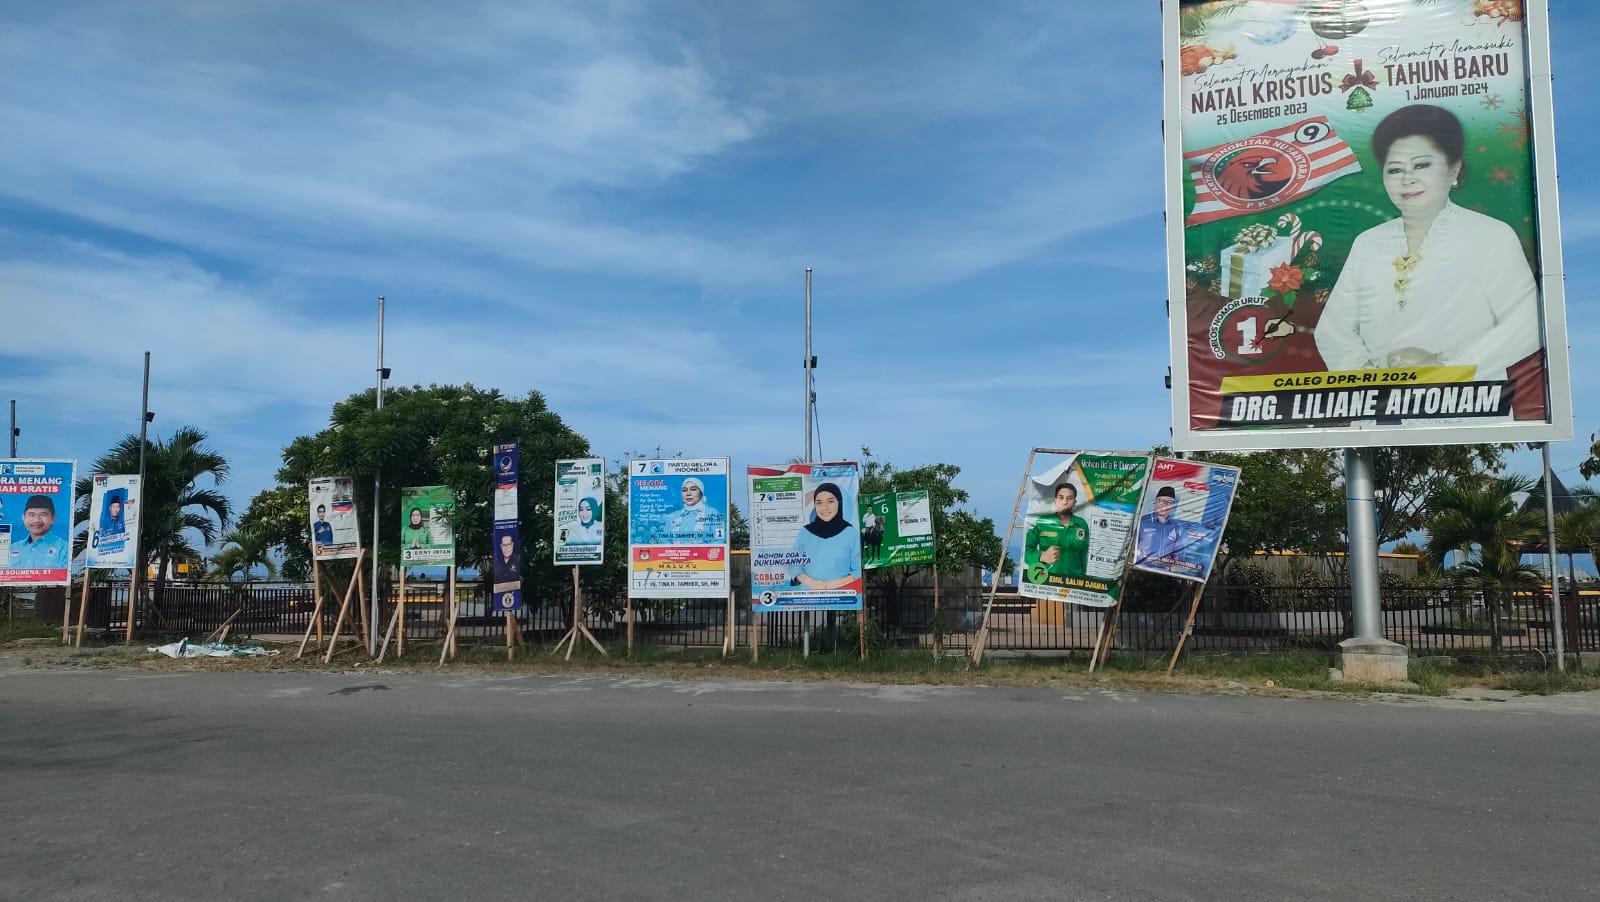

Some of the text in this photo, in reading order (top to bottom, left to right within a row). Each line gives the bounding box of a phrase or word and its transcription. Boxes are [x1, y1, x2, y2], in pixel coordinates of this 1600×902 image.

[1384, 52, 1509, 87] TAHUN BARU
[1191, 72, 1333, 114] NATAL KRISTUS
[1405, 90, 1411, 101] 1
[1461, 82, 1489, 96] 2024
[1216, 114, 1228, 126] 25
[1284, 102, 1308, 116] 2023
[1303, 125, 1320, 141] 9
[1203, 172, 1223, 196] PARTAI
[1274, 140, 1308, 180] NUSANTARA
[1210, 297, 1266, 358] COBLOS NOMOR URUT
[1236, 316, 1263, 355] 1
[1273, 371, 1417, 388] CALEG DPR-RI 2024
[1230, 385, 1502, 422] DRG. LILIANE AITONAM
[638, 463, 647, 473] 7
[1081, 459, 1100, 469] Mohon
[18, 477, 63, 485] MENANG
[20, 485, 59, 493] GRATIS
[881, 503, 889, 514] 6
[92, 530, 100, 549] 6
[717, 529, 723, 538] 1
[405, 551, 412, 560] 3
[753, 557, 812, 567] DUKUNGANNYA
[753, 573, 786, 581] COBLOS
[1048, 575, 1064, 583] EMIL
[763, 592, 773, 605] 3
